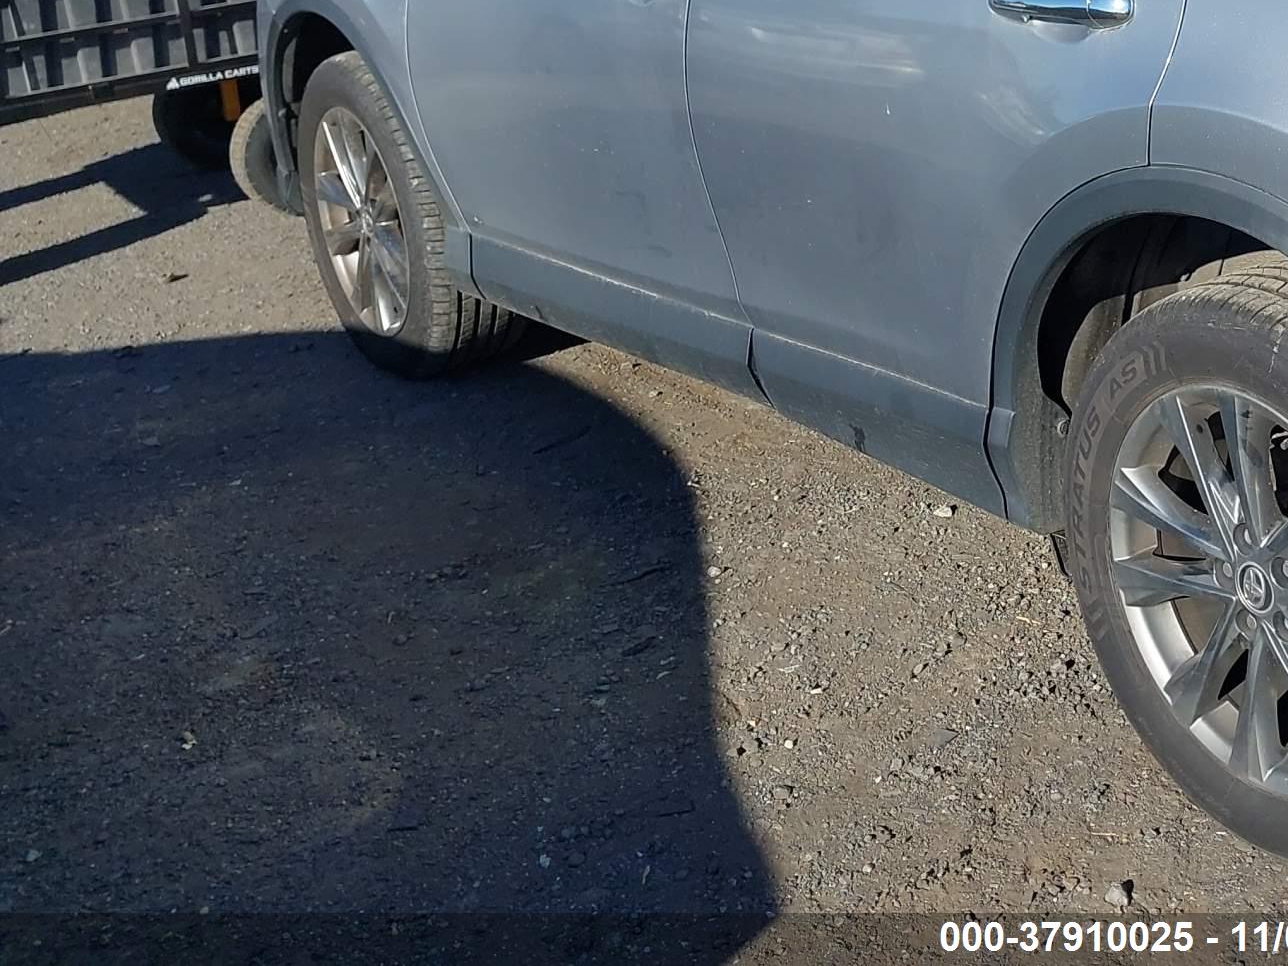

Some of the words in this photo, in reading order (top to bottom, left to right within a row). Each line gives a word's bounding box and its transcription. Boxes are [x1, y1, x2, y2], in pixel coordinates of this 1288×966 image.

[180, 71, 223, 87] GORILLA
[224, 65, 259, 79] CARTS
[1070, 405, 1102, 597] STRATUS
[1106, 358, 1139, 401] AS
